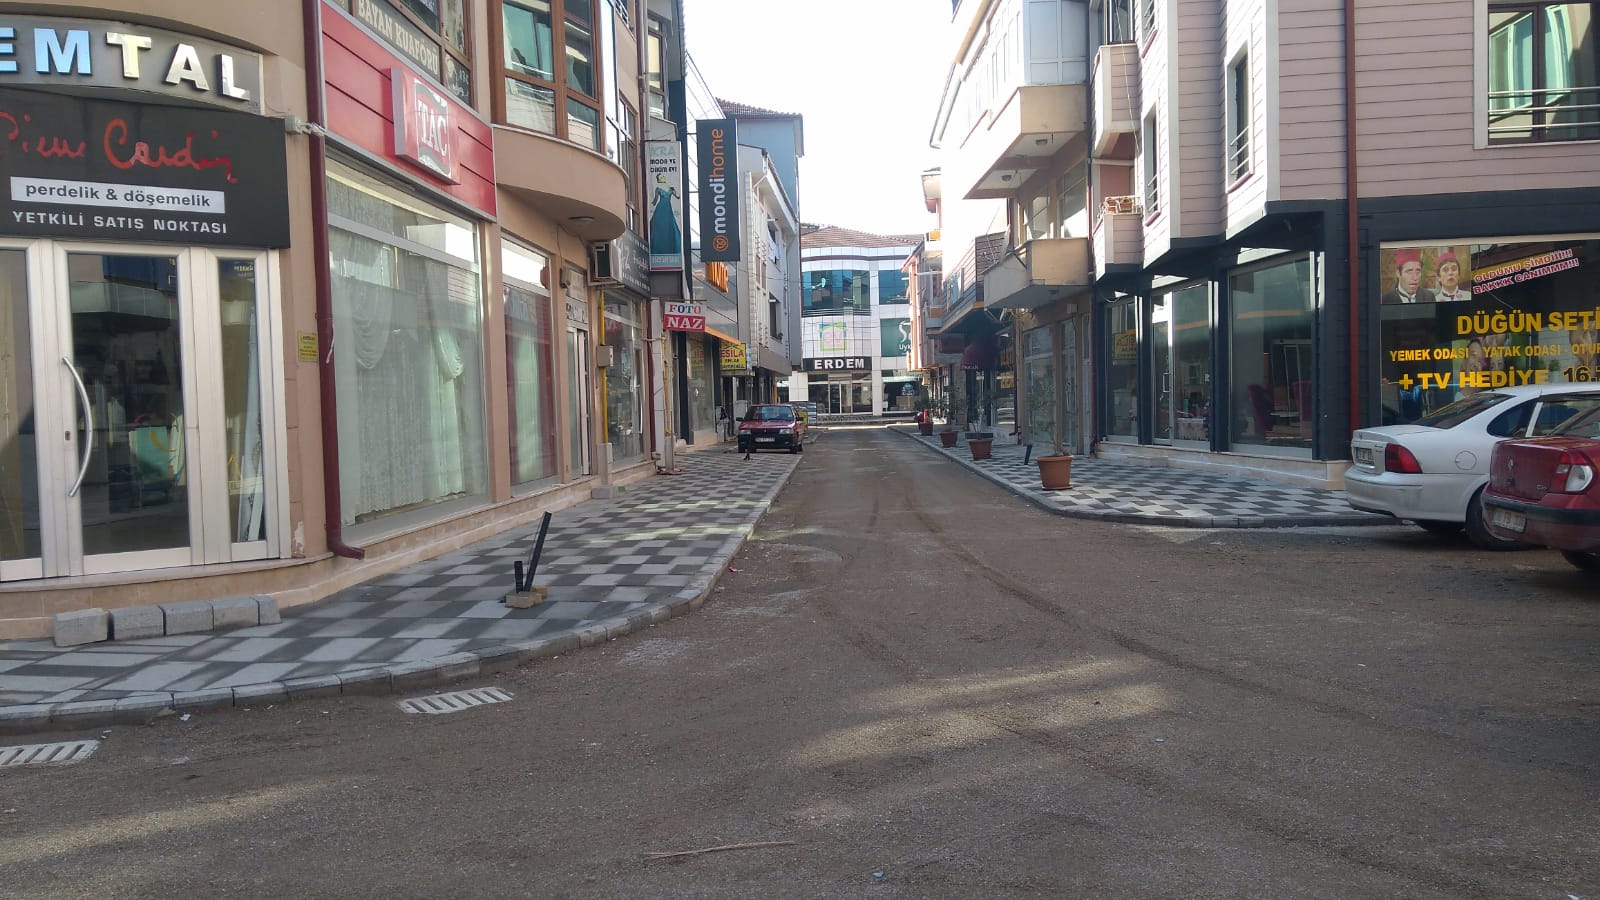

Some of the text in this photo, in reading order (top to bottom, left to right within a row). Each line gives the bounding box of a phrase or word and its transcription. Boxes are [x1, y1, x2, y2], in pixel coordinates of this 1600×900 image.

[104, 118, 238, 183] Cardin
[709, 128, 727, 234] mondihome
[26, 184, 210, 206] perdelik & döşemelik
[12, 211, 227, 234] YETKİLİ SATIŞ NOKTASI
[1473, 263, 1521, 283] OLDUMU
[670, 304, 702, 314] FOTO
[667, 316, 703, 330] NAZ
[1457, 309, 1543, 335] DÜĞÜN
[1390, 348, 1431, 361] YEMEK
[1433, 347, 1470, 360] ODASI
[1483, 345, 1521, 358] YATAK
[1525, 344, 1561, 356] ODASI
[814, 358, 865, 370] ERDEM
[1417, 372, 1452, 390] TV
[1459, 365, 1550, 388] HEDİYE
